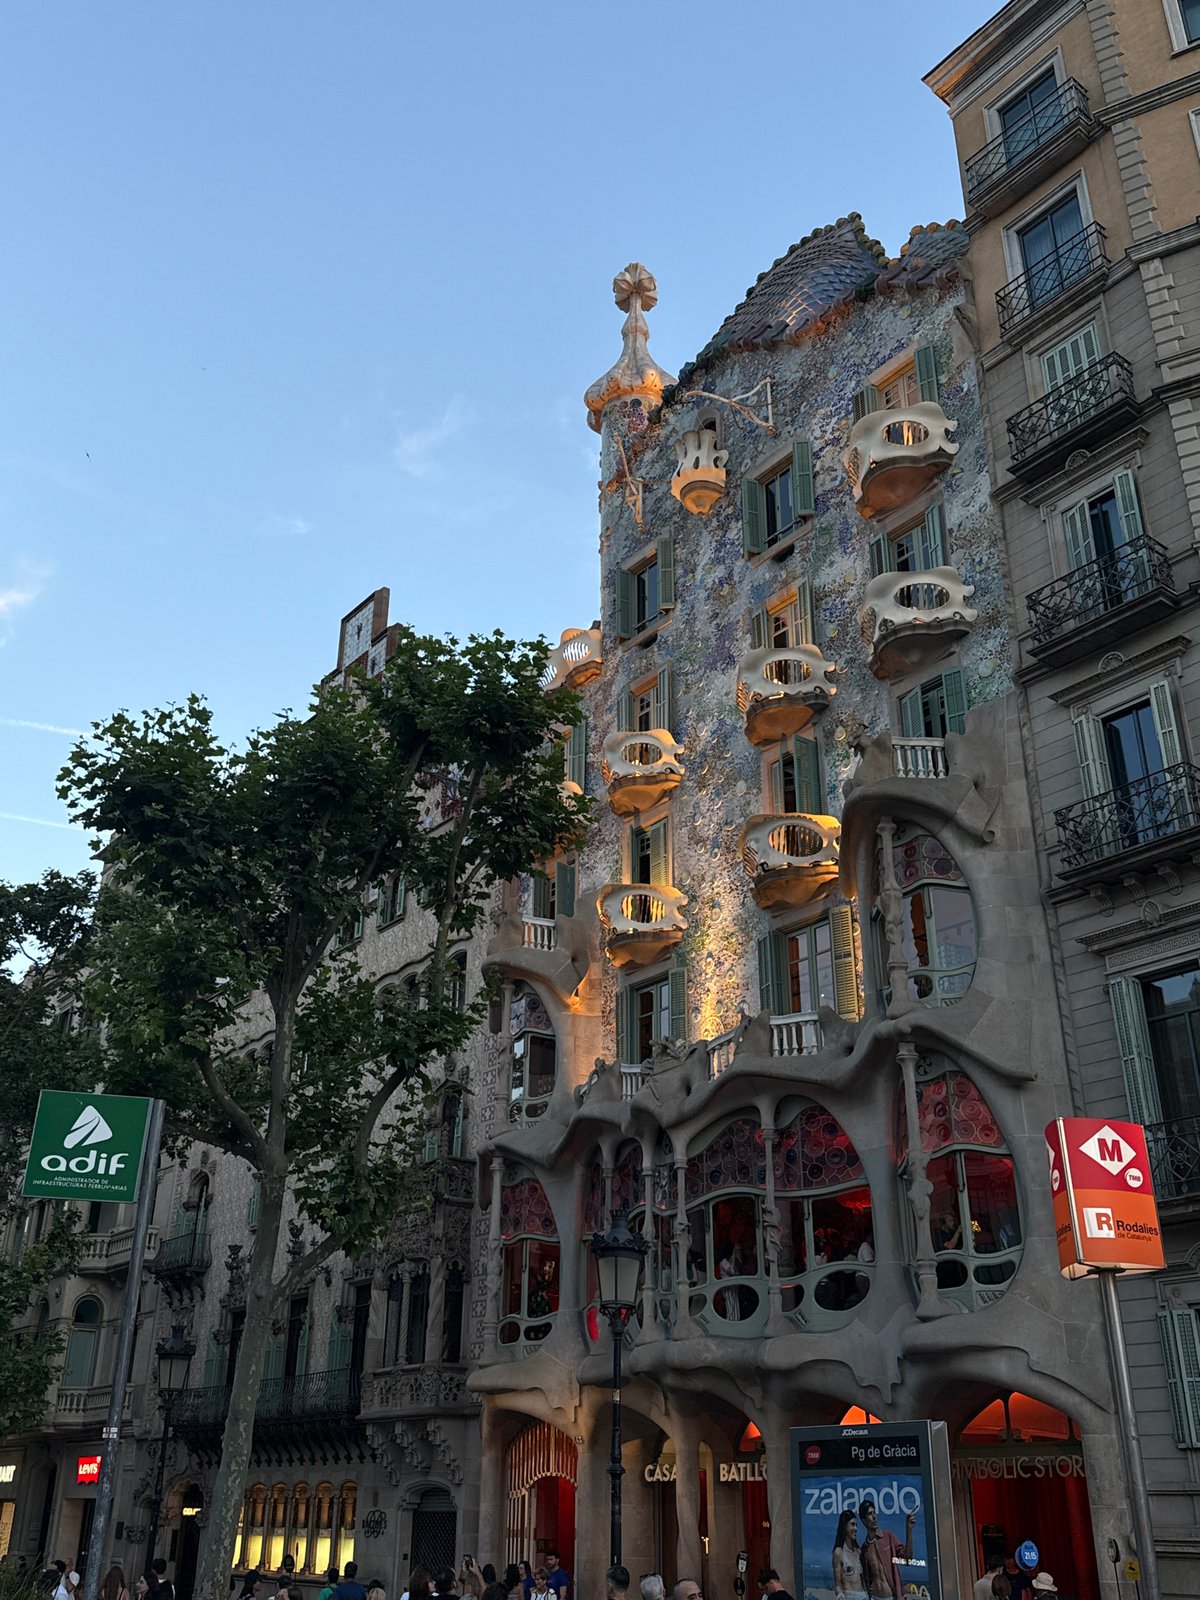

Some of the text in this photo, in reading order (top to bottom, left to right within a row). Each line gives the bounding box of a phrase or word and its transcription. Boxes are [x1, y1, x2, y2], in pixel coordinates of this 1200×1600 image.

[1097, 1138, 1124, 1163] M
[41, 1150, 129, 1175] adif
[32, 1179, 87, 1188] INFRAESTRUCTURAS
[53, 1176, 99, 1185] ADMINISTRADOR
[1095, 1213, 1114, 1231] R
[1116, 1220, 1159, 1236] Rodalies
[1126, 1232, 1152, 1243] Catalunya
[841, 1428, 868, 1436] JCDecaux
[851, 1444, 917, 1461] Pg de Gràcia
[804, 1481, 921, 1515] zalando
